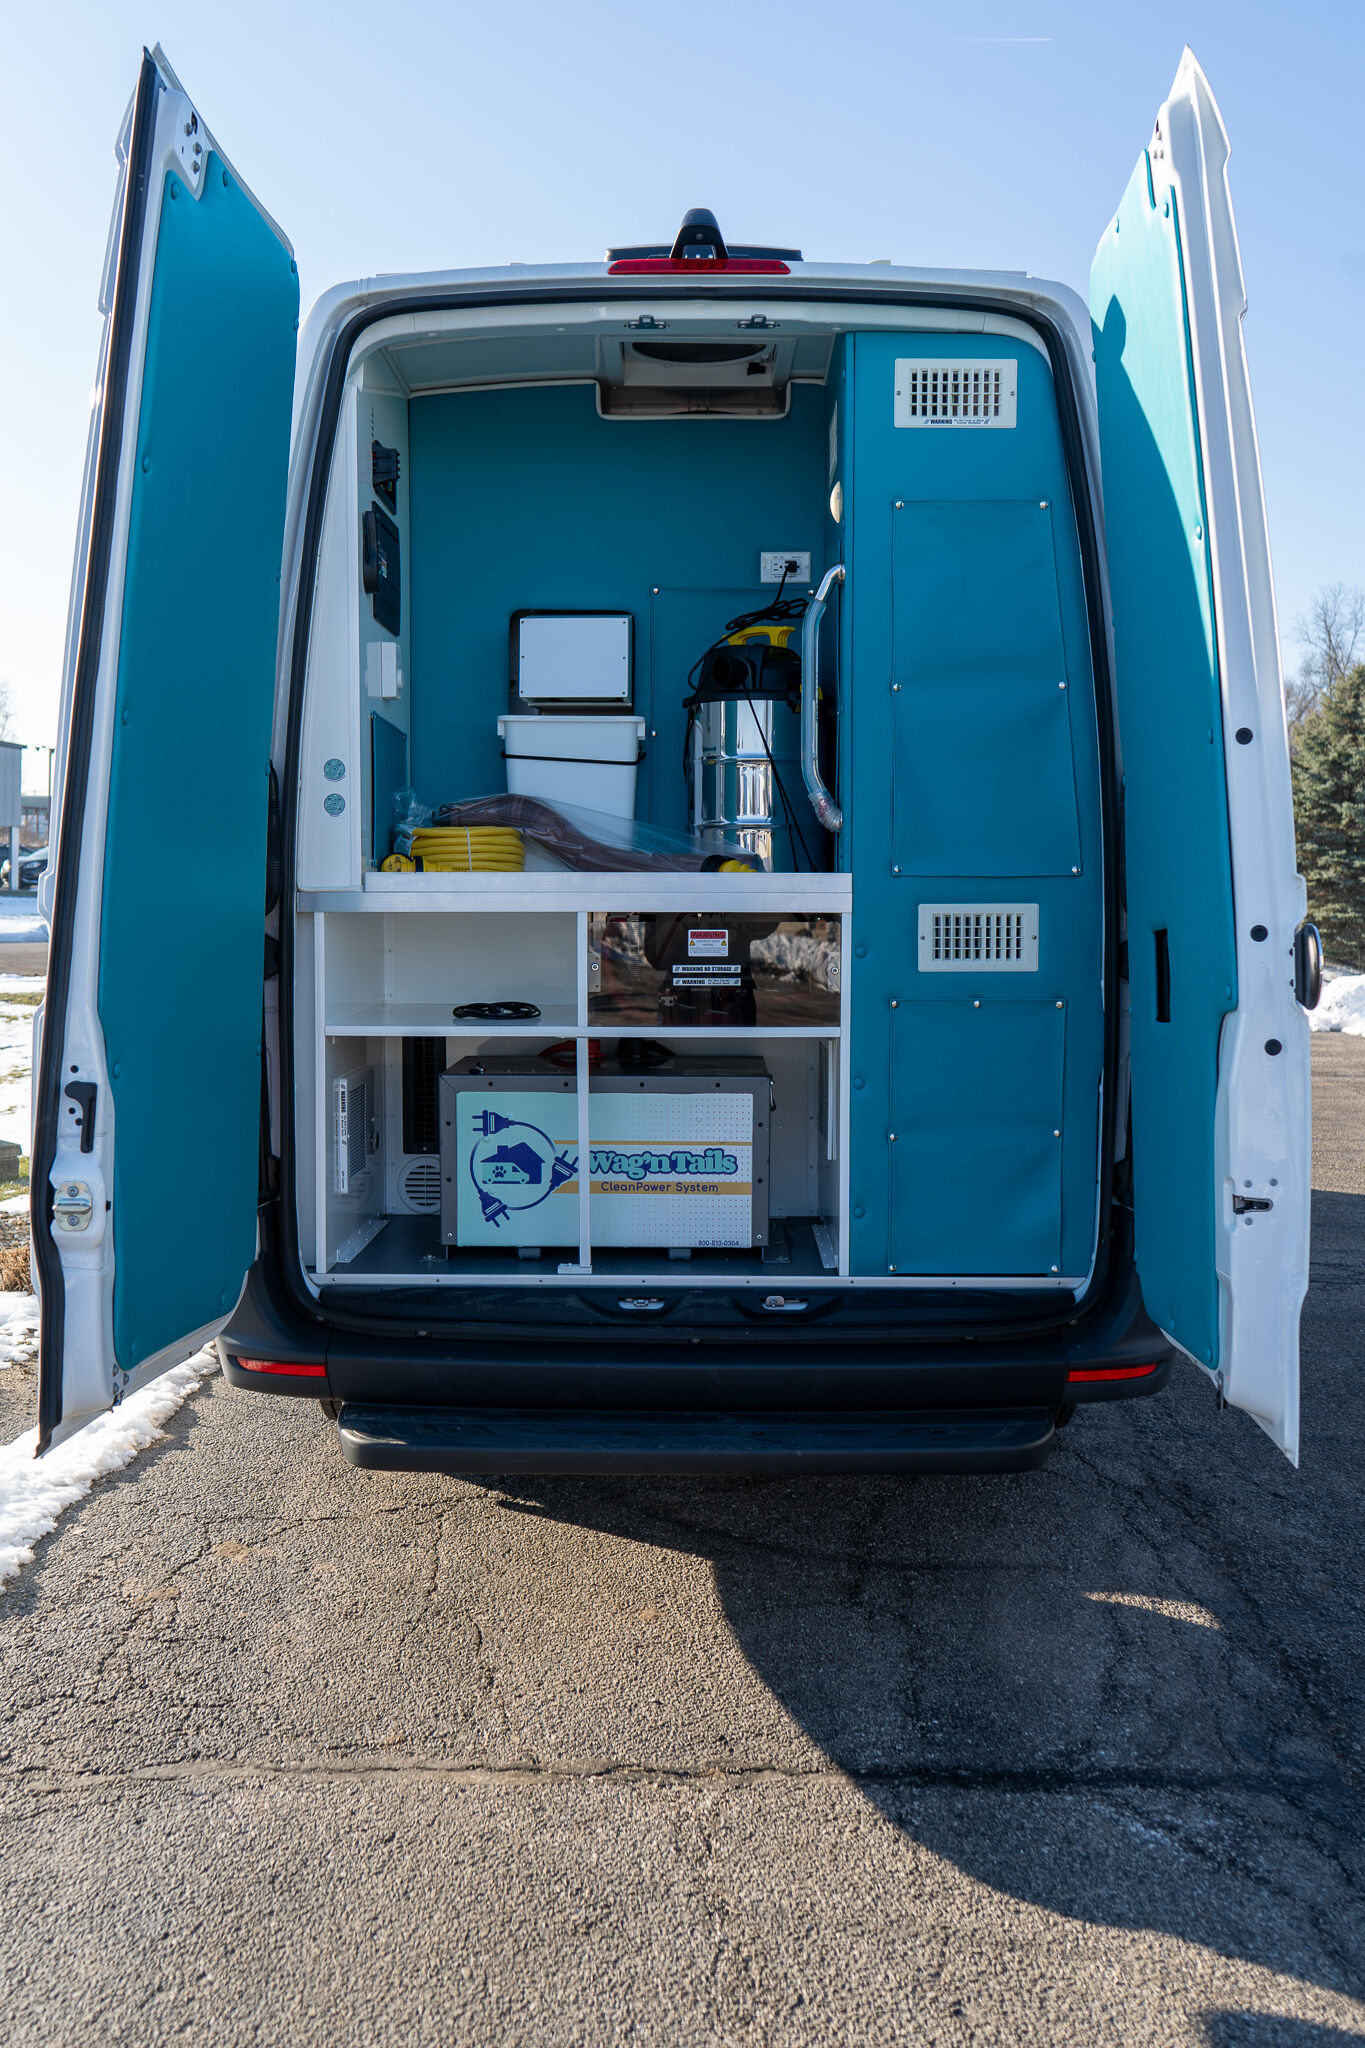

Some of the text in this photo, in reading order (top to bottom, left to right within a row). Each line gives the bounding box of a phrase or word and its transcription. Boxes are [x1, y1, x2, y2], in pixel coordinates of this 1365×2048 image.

[590, 1148, 738, 1181] Wag'n Tails
[600, 1181, 719, 1194] CleanPower System
